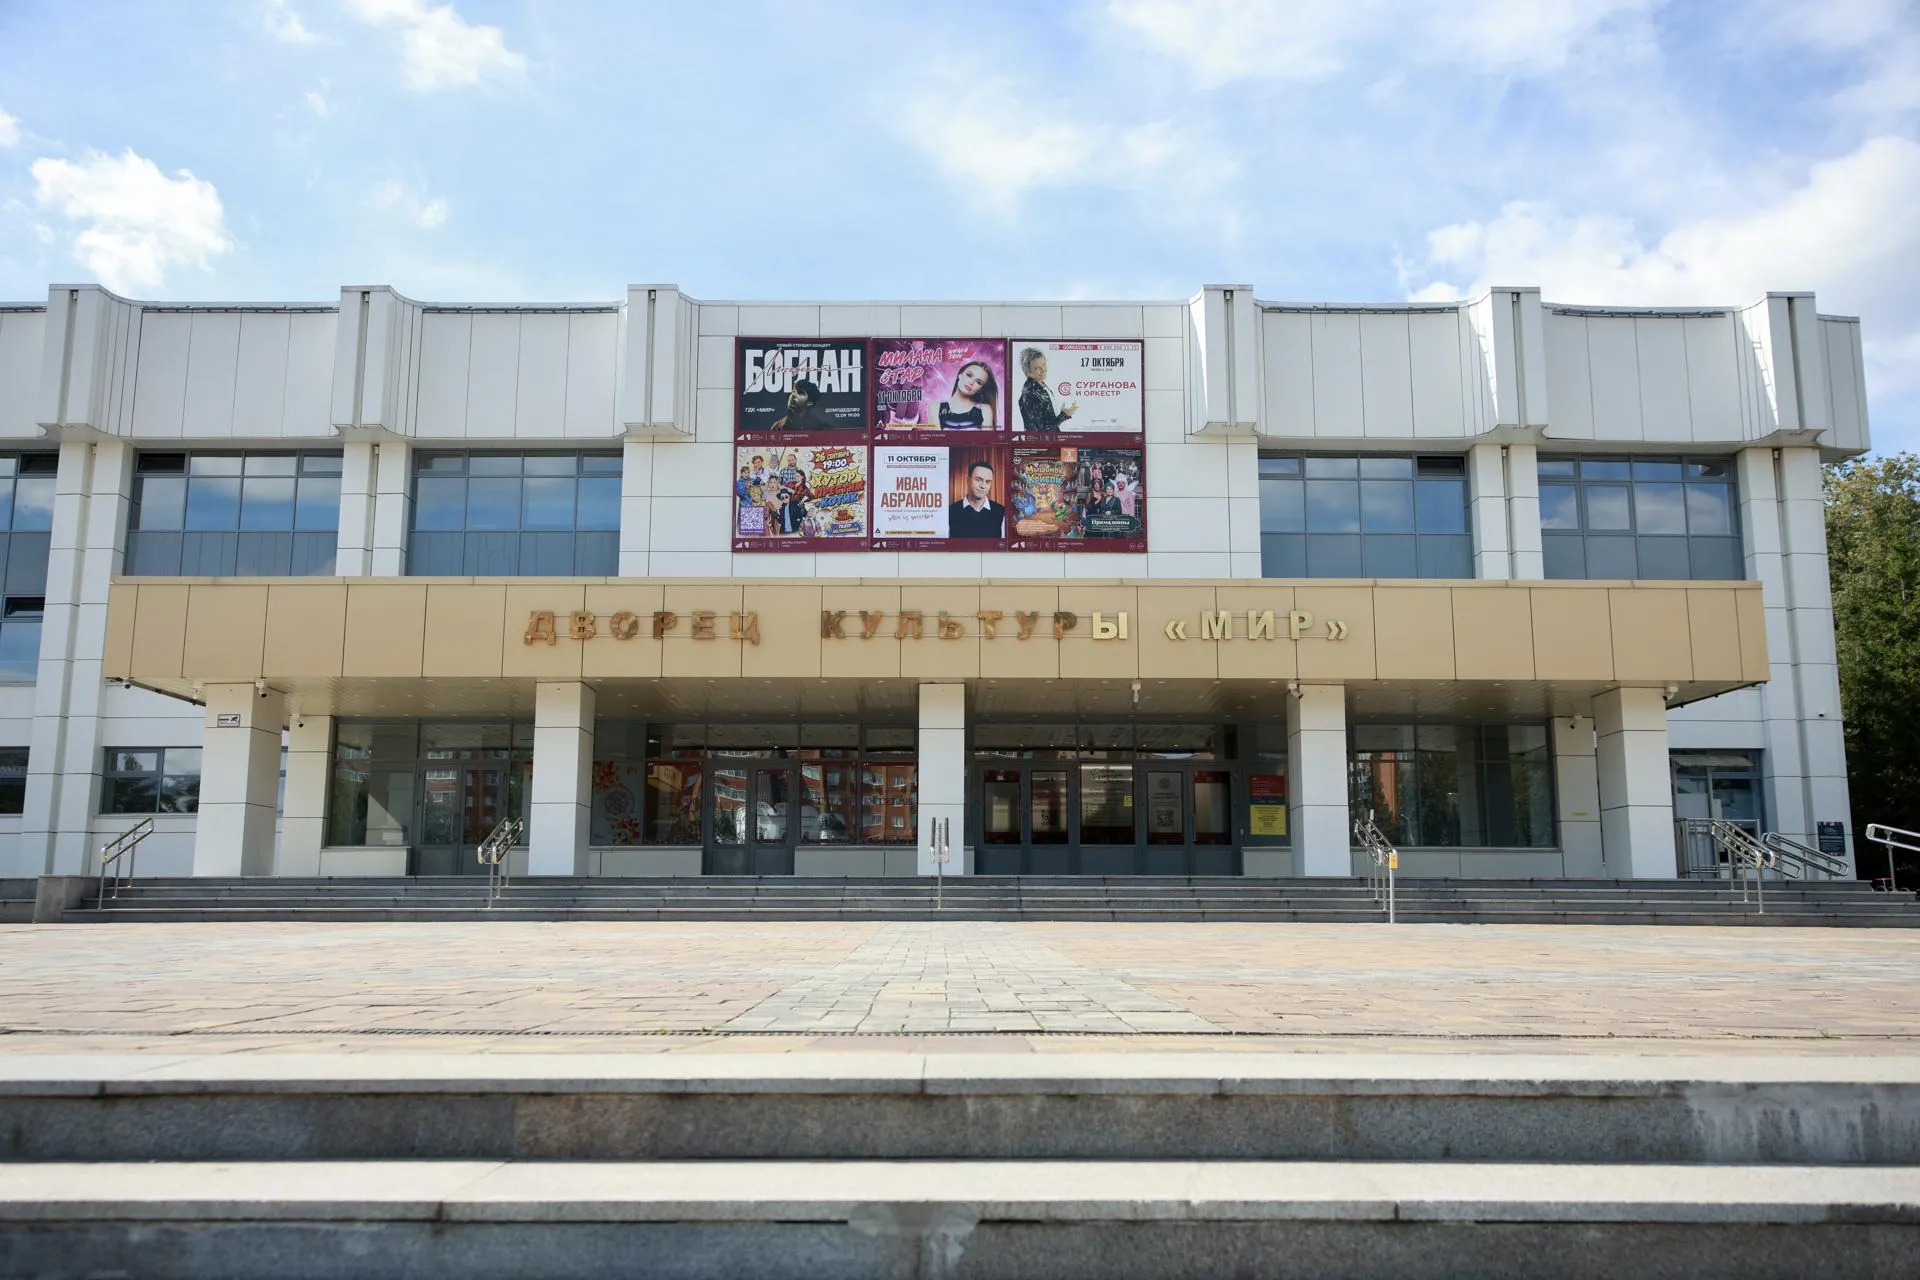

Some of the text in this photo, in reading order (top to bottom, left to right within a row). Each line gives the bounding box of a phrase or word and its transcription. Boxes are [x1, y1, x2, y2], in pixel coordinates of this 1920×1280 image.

[878, 347, 943, 366] МИЛАНА
[1081, 358, 1124, 367] 17 ОКТЯБРЯ
[745, 349, 861, 392] БОГДАН
[880, 366, 924, 385] СТАР
[1076, 381, 1137, 389] СУРГАНОВА
[815, 453, 826, 462] 26
[823, 458, 847, 469] 19:00
[813, 472, 857, 489] ХУТОР
[896, 477, 927, 491] ИВАН
[881, 493, 943, 508] АБРАМОВ
[524, 609, 1349, 645] ДВОРЕЦ КУЛЬТУРЫ «МИР»
